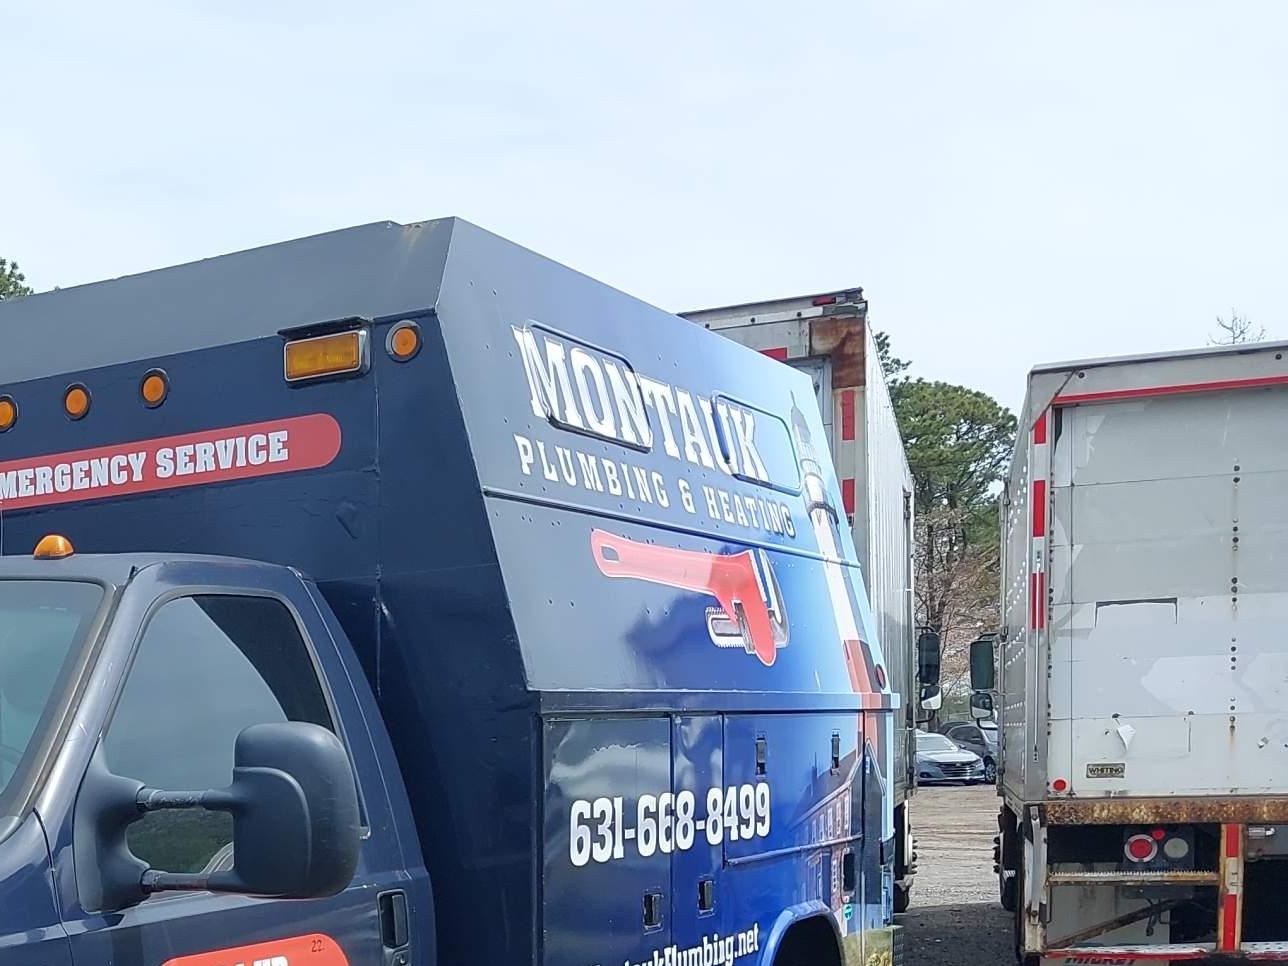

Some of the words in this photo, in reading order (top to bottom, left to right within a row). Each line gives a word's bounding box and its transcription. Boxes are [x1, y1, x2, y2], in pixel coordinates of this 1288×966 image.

[511, 324, 770, 482] MONTAUK
[155, 429, 289, 478] SERVICE
[513, 434, 670, 508] PLUMBING
[677, 478, 697, 514] &
[702, 484, 797, 538] HEATING
[1088, 767, 1124, 776] WHITING
[569, 782, 771, 867] 631-668-8499
